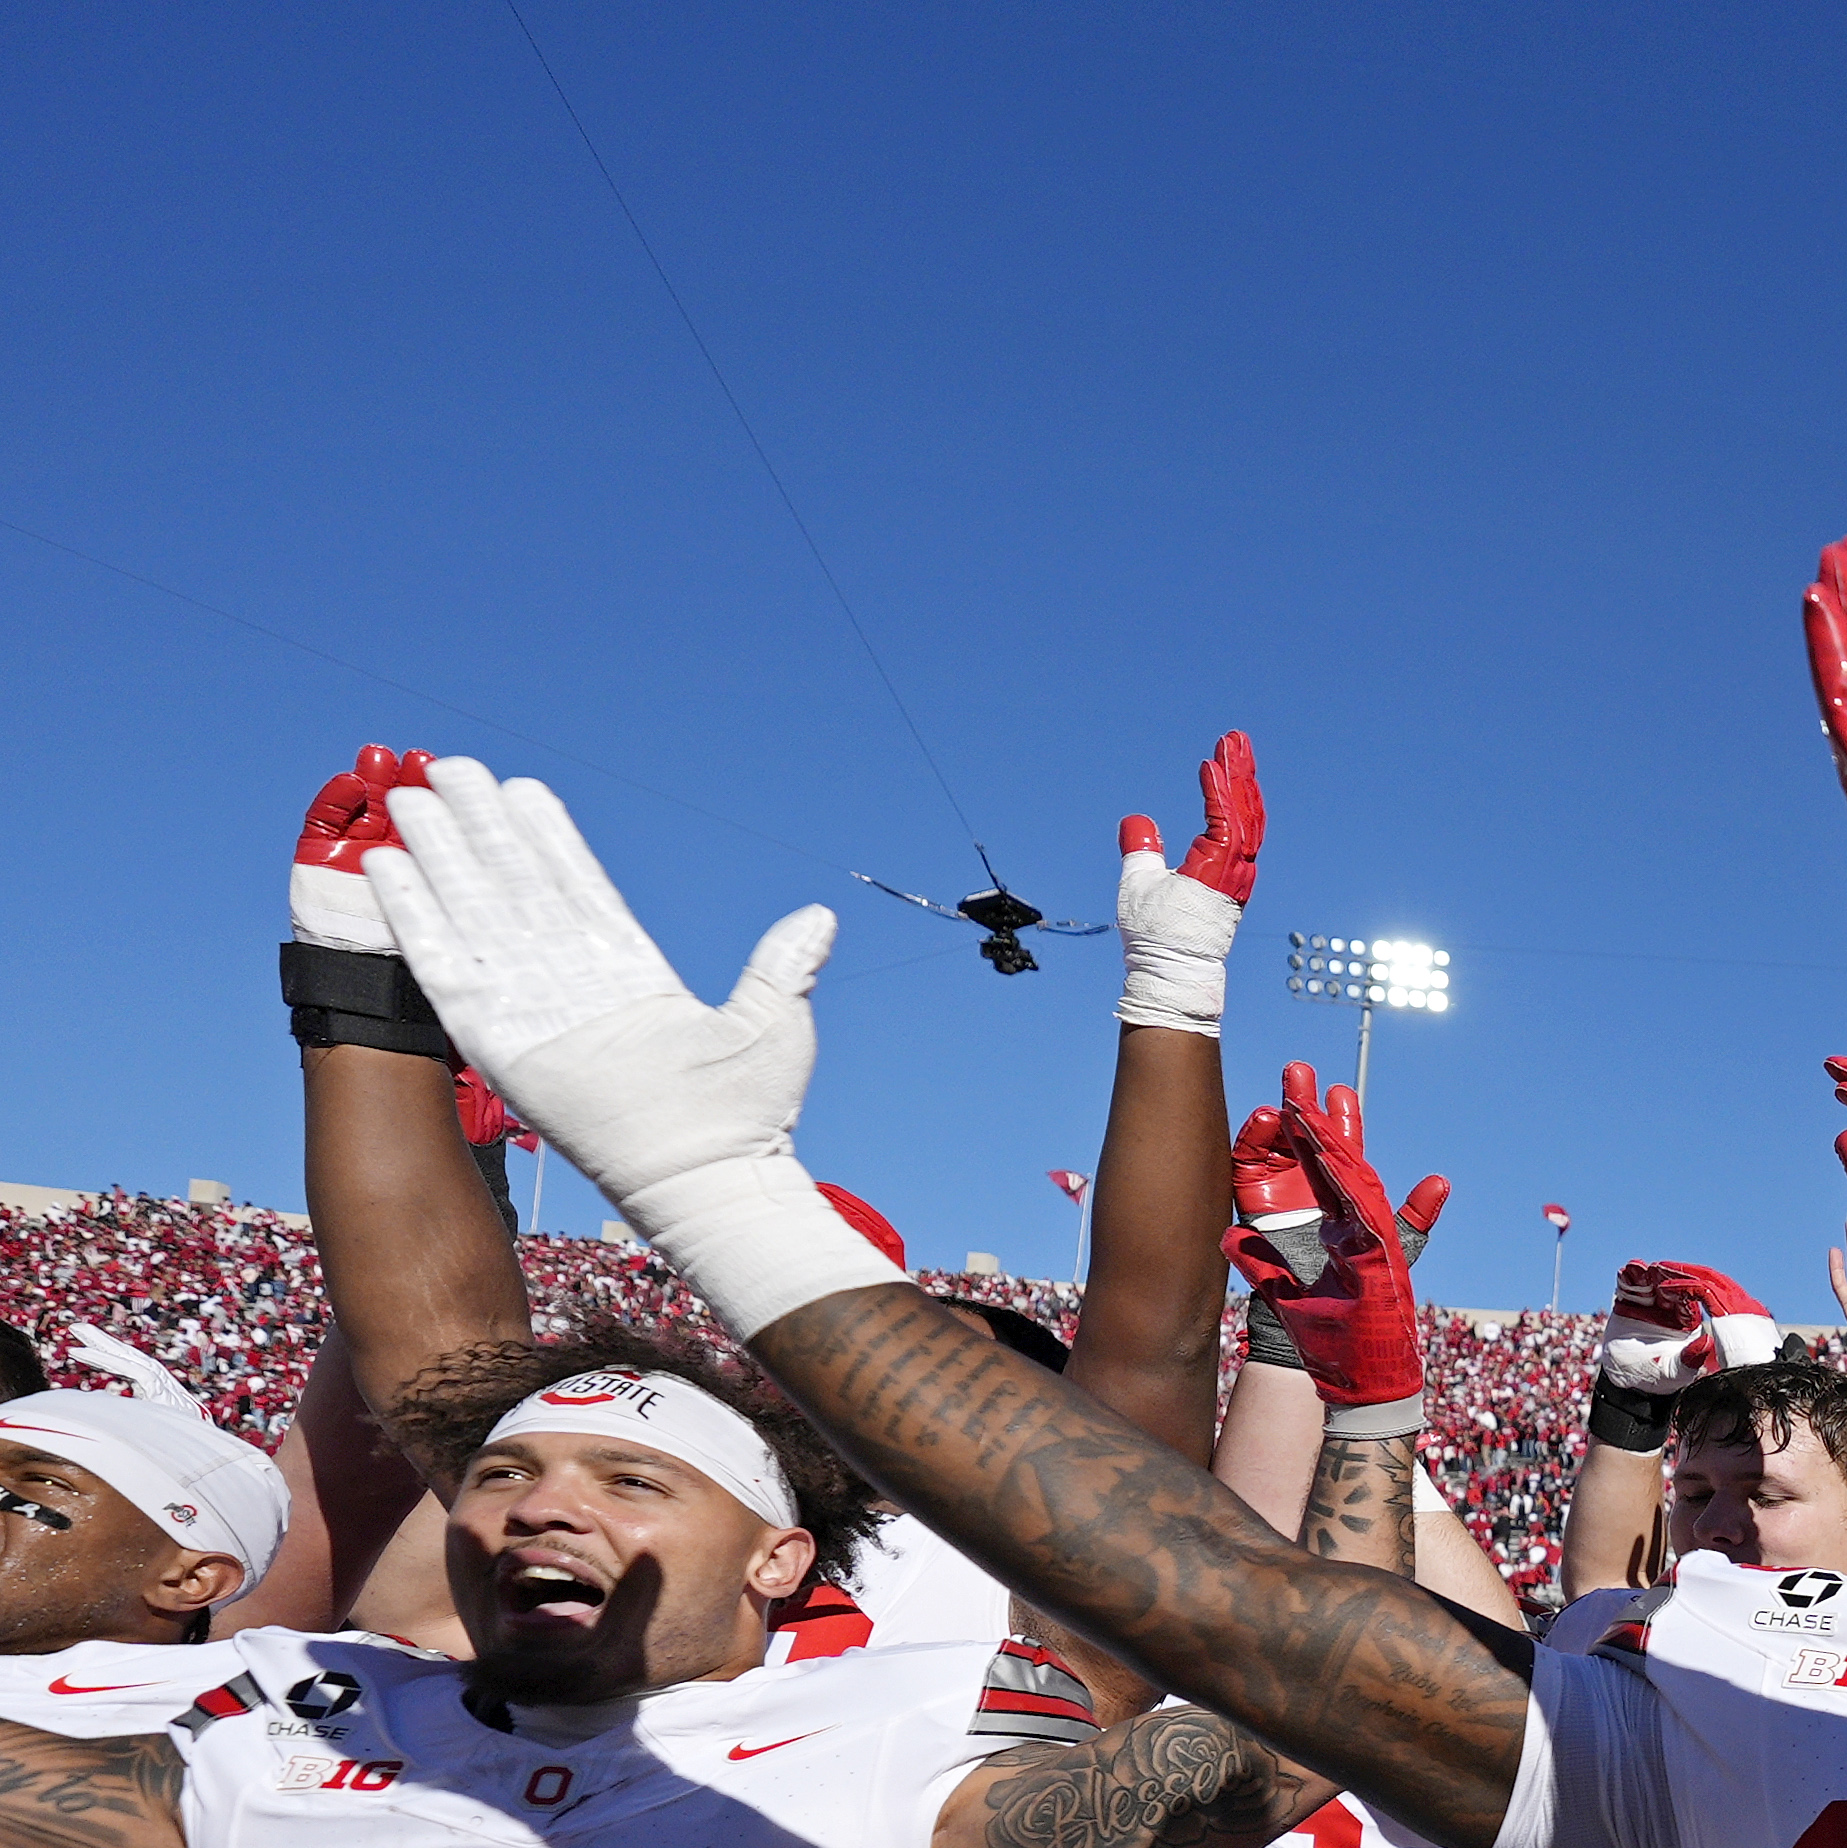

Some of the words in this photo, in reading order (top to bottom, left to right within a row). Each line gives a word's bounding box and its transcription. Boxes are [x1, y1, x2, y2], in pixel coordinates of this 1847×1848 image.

[1753, 1610, 1834, 1632] CHASE
[267, 1721, 350, 1740] CHASE
[523, 1765, 575, 1805] O
